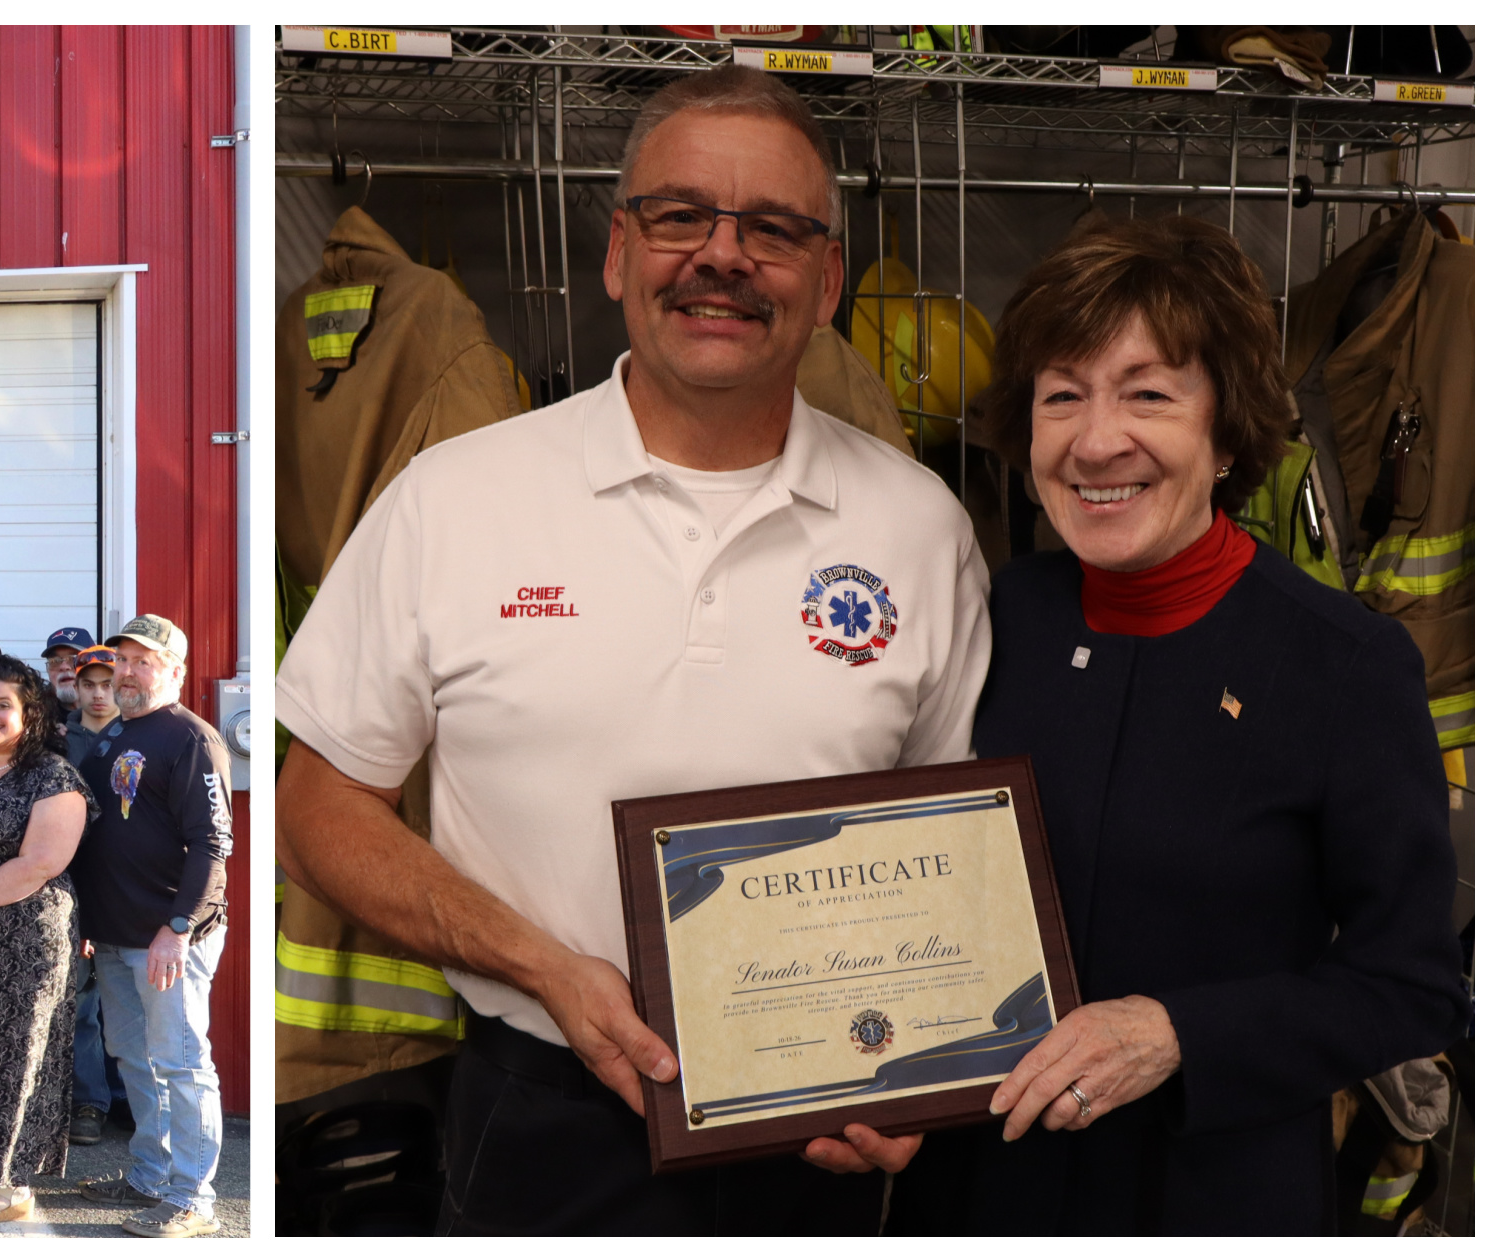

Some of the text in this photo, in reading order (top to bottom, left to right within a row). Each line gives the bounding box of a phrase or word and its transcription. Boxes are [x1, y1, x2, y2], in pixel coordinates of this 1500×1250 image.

[329, 31, 390, 50] C.BIRT
[768, 53, 828, 70] R.WYMAN
[1136, 70, 1185, 85] J.WYMAN
[1399, 86, 1442, 100] R.GREEN
[820, 567, 881, 591] BROWNVILLE
[517, 586, 565, 601] CHIEF
[500, 603, 579, 618] MITCHELL
[823, 641, 874, 661] FIRE RESCUE
[740, 853, 952, 899] CERTIFICATE
[797, 888, 904, 908] OF APPRECIATION
[795, 922, 839, 932] CERTIFICATE
[849, 917, 879, 925] PROUDLY
[882, 912, 918, 921] PRESENTED
[735, 934, 963, 985] Senator Susan Collins
[723, 1009, 750, 1019] provide
[761, 1002, 798, 1012] Brownville
[844, 993, 864, 1001] Thank
[892, 987, 916, 995] making
[930, 980, 965, 989] community
[732, 1000, 760, 1010] grateful
[762, 994, 803, 1005] appreciation
[928, 972, 971, 982] contributions
[936, 1028, 960, 1036] Chief
[780, 1050, 803, 1059] DATE
